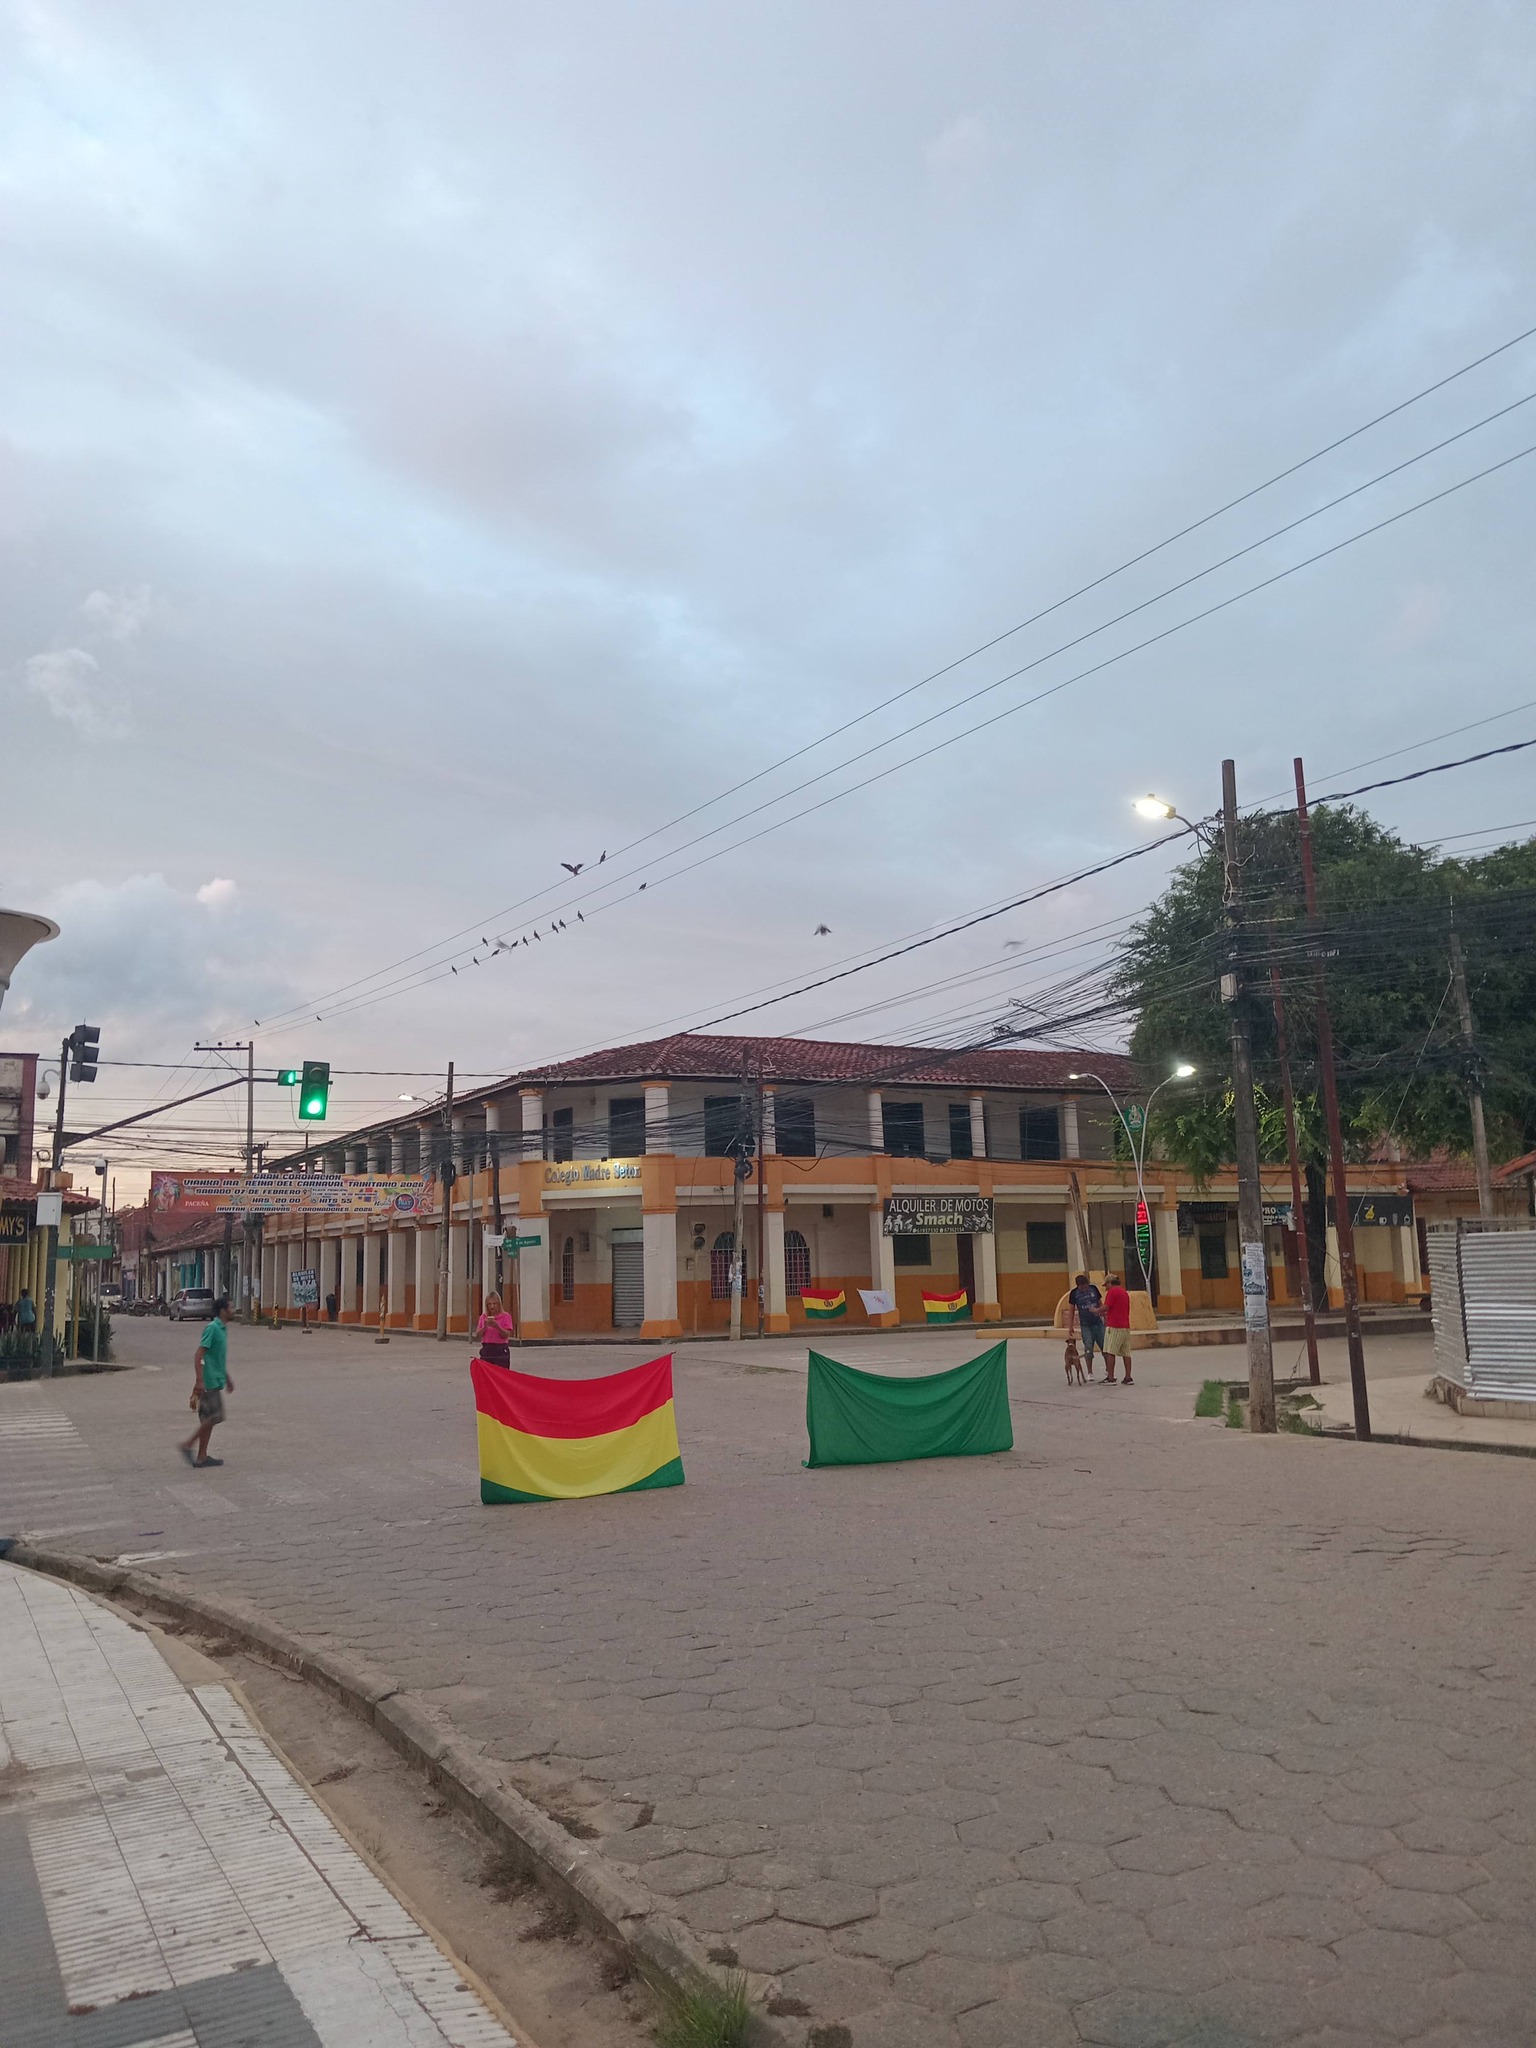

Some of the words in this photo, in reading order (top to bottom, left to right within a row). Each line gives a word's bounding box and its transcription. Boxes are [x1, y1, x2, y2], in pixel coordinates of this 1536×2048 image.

[282, 1173, 341, 1181] CORONACION
[544, 1166, 579, 1186] Colegio
[583, 1164, 611, 1181] Madre
[296, 1180, 345, 1188] CARNAVAL
[889, 1199, 937, 1213] ALQUILER
[940, 1199, 954, 1212] DE
[955, 1198, 989, 1212] MOTOS
[915, 1212, 963, 1226] Smach
